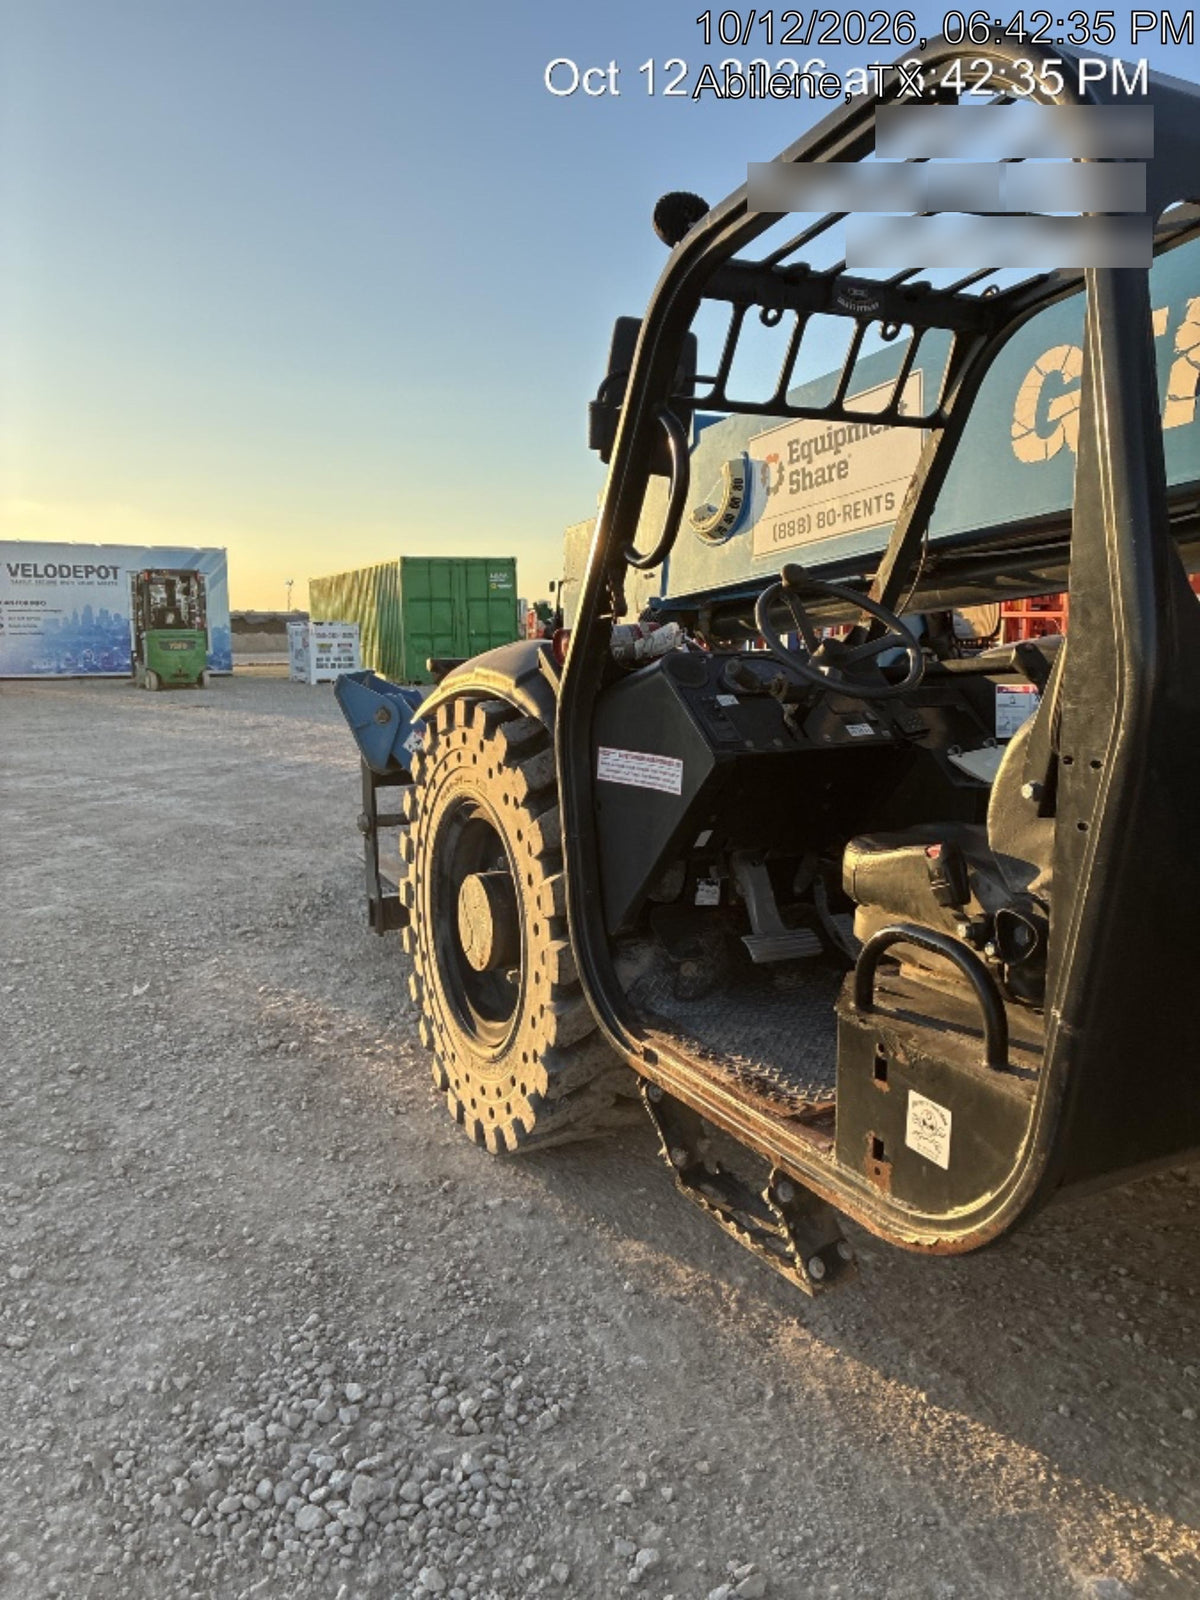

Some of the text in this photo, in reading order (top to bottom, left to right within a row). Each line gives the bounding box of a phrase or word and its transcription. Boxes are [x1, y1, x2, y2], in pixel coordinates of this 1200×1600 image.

[733, 477, 744, 491] 80
[789, 459, 849, 494] Share
[772, 492, 896, 542] (888) 80-RENTS
[6, 563, 120, 580] VELODEPOT
